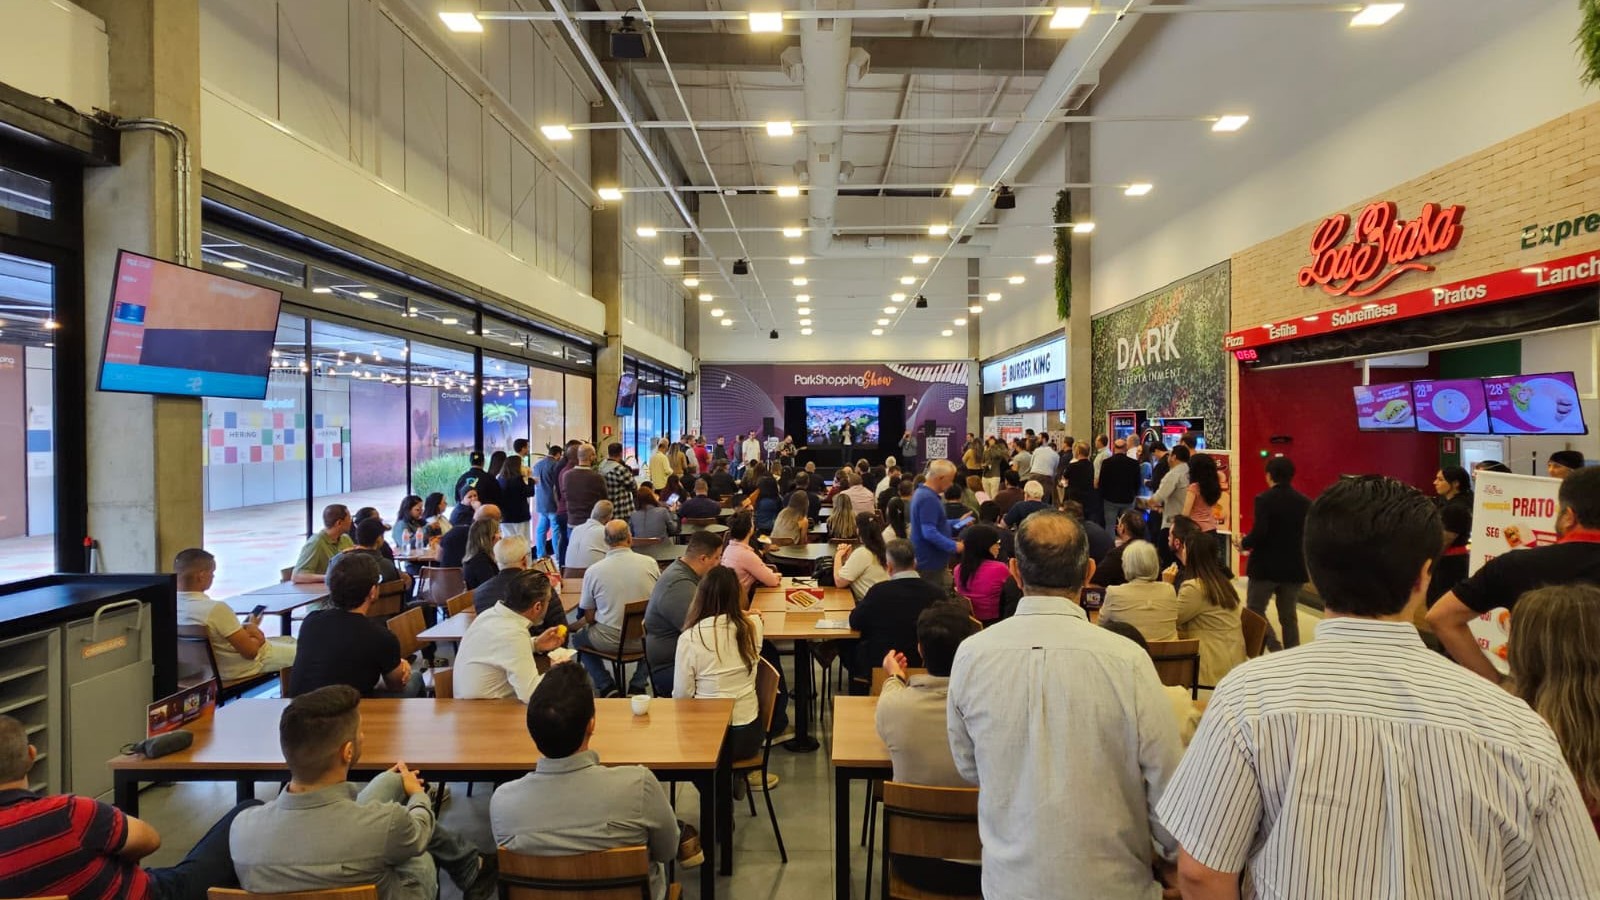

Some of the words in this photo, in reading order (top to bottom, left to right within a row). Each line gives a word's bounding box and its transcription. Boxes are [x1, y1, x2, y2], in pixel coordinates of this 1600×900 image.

[1521, 213, 1600, 250] Expre
[1298, 213, 1355, 287] La
[1338, 201, 1465, 296] Brasa
[1536, 255, 1600, 287] Lanch
[1433, 283, 1487, 306] Pratos
[1331, 303, 1398, 327] Sobremesa
[1225, 335, 1244, 348] Pizza
[1269, 323, 1297, 340] Esfiha
[1117, 320, 1181, 371] DARK
[1236, 350, 1258, 360] 068
[1009, 359, 1032, 382] BURGER
[1033, 352, 1051, 376] KING
[1117, 367, 1182, 386] ENTERTAINMENT
[1512, 497, 1555, 518] PRATO
[1485, 526, 1500, 538] SEG
